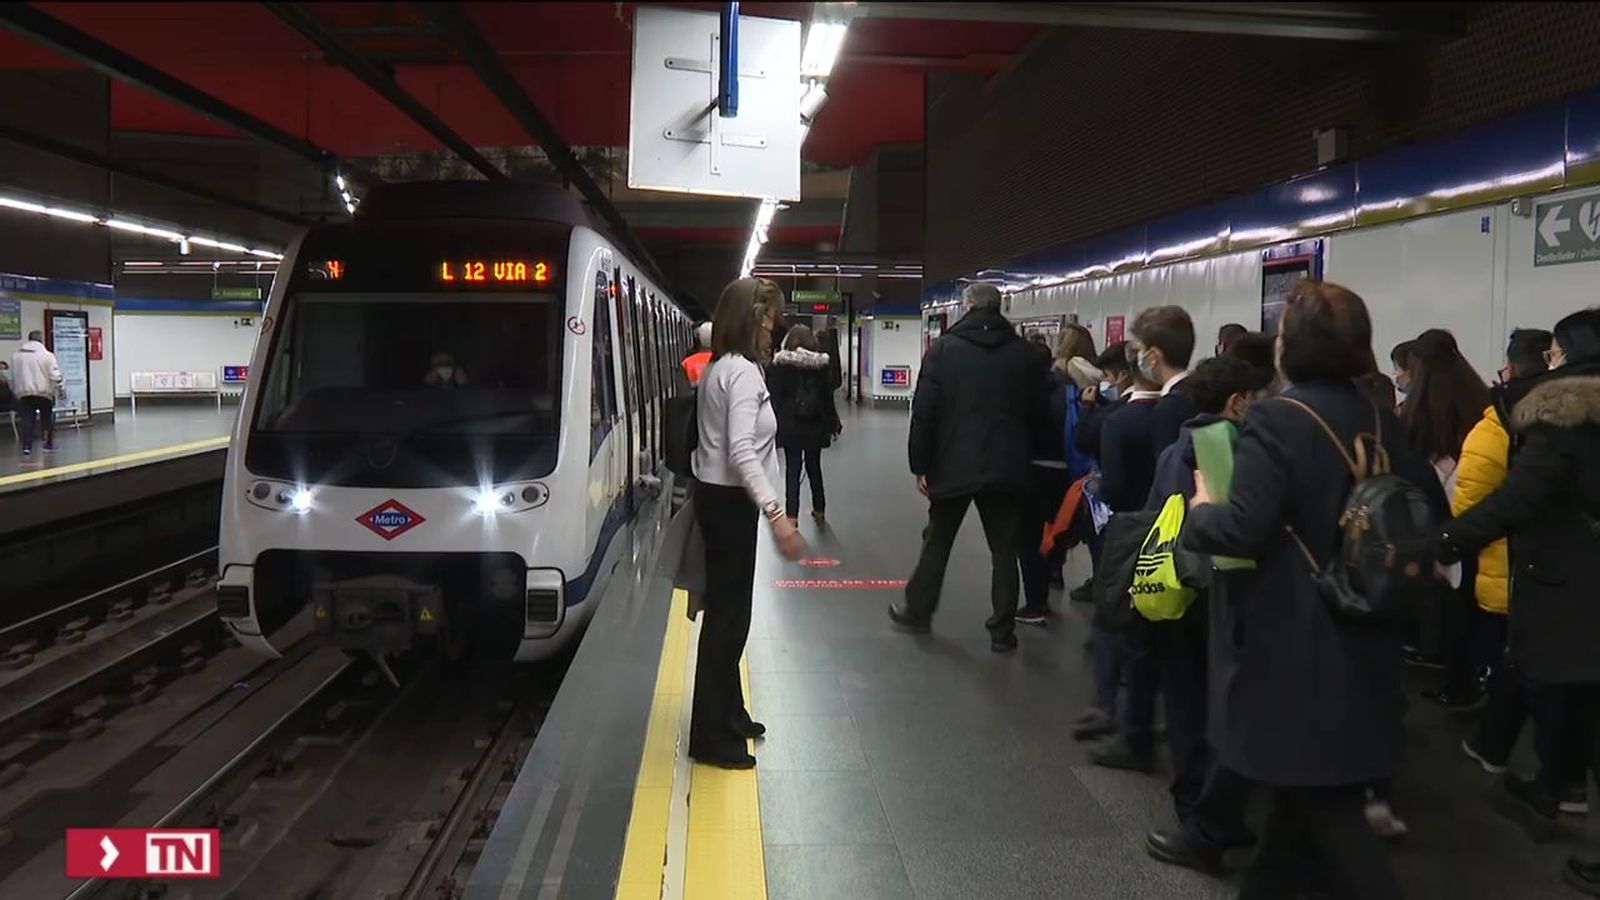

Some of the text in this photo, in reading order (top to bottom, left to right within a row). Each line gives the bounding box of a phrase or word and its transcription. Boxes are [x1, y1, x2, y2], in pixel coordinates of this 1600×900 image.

[442, 261, 547, 280] L 12 VIA 2
[374, 514, 406, 525] Metro
